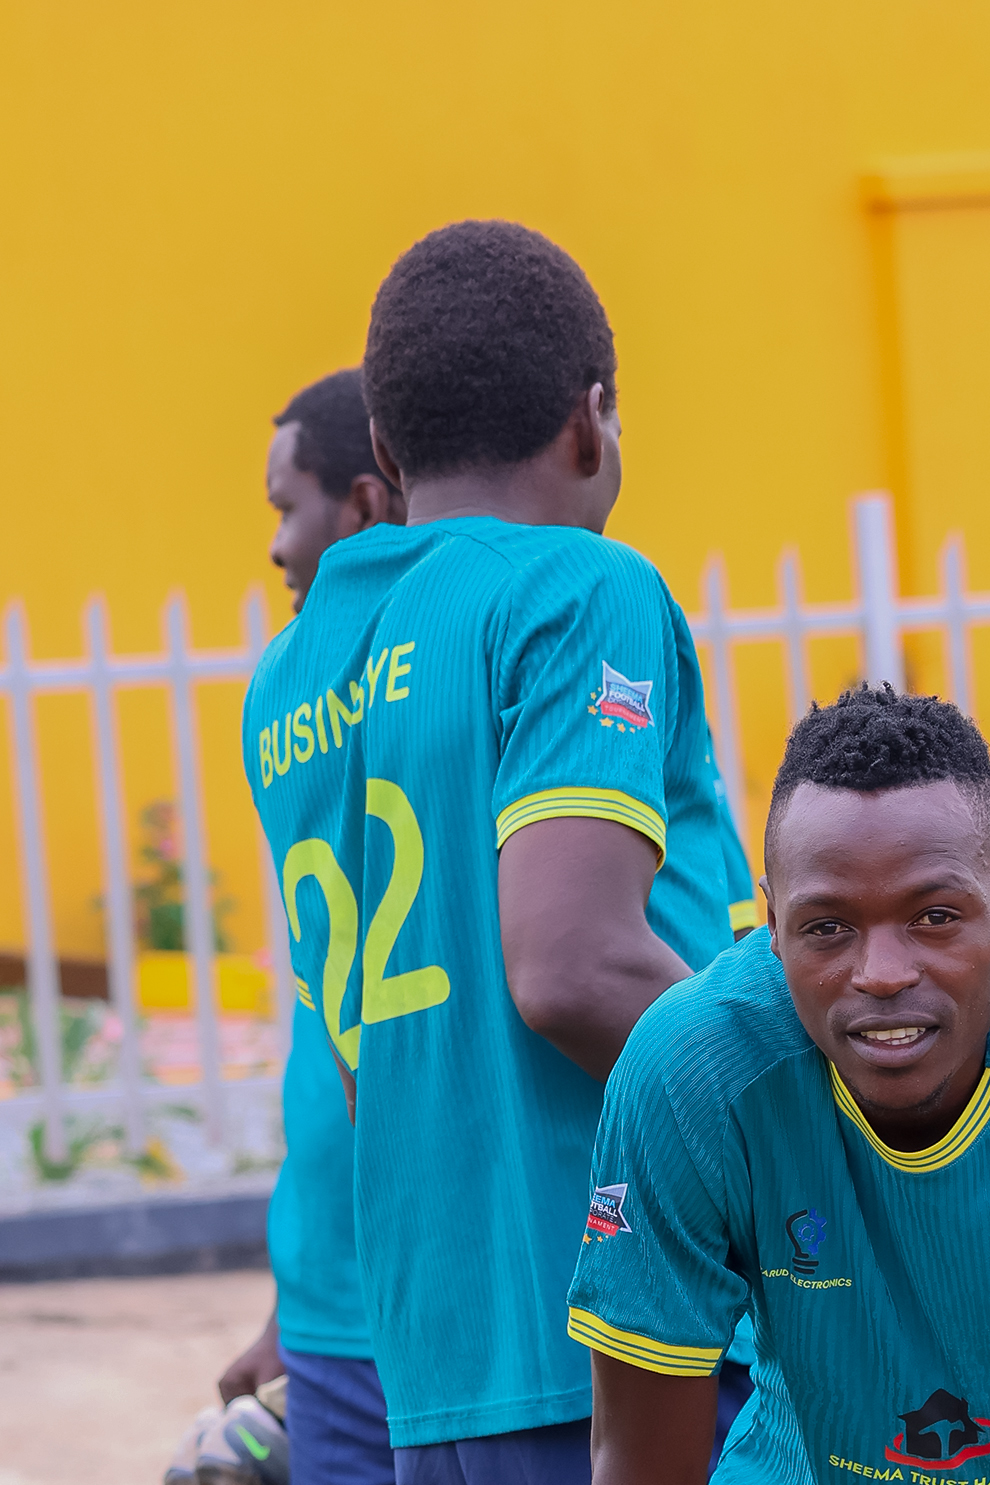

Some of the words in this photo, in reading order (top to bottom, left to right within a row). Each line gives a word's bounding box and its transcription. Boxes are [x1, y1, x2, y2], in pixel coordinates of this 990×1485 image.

[609, 691, 645, 712] FOOTBALL
[283, 778, 450, 1071] 22
[760, 1267, 789, 1278] ARUD
[790, 1273, 852, 1289] ELECTRONICS
[828, 1454, 904, 1481] SHEEMA
